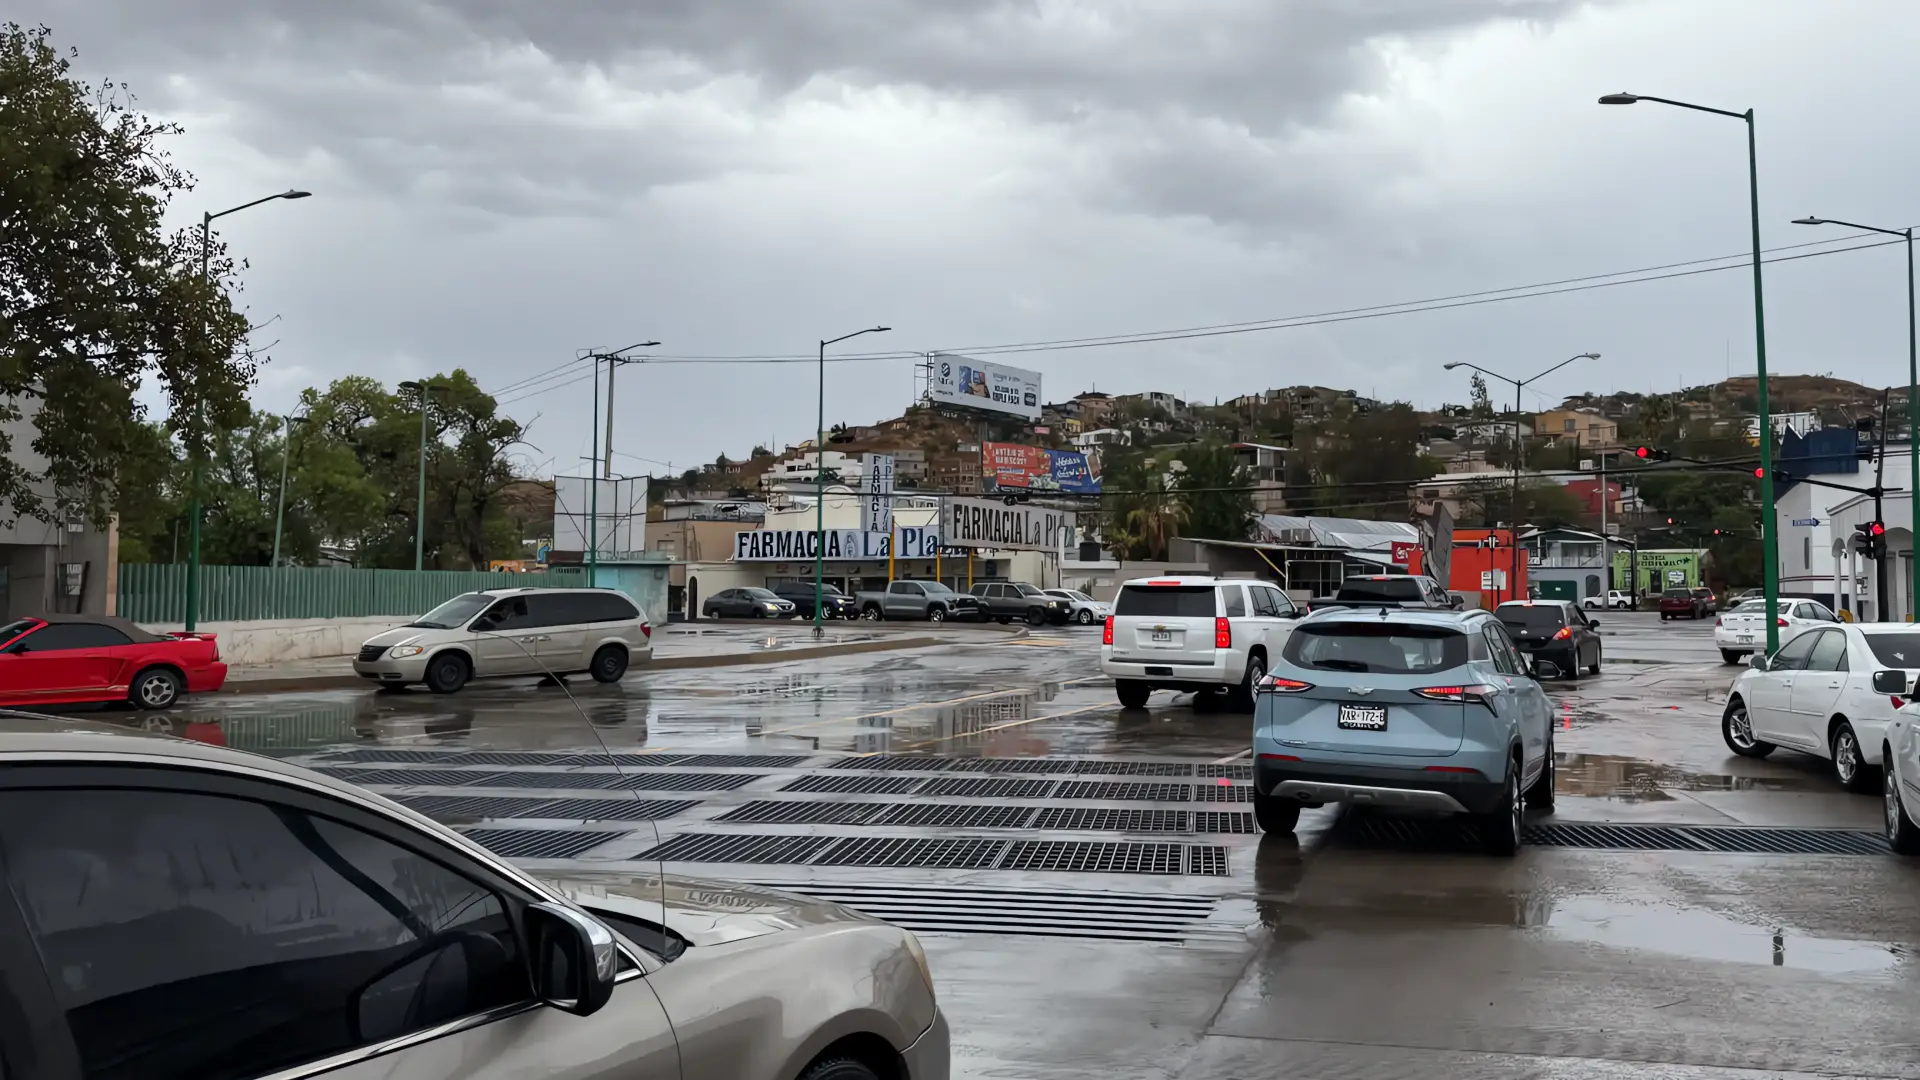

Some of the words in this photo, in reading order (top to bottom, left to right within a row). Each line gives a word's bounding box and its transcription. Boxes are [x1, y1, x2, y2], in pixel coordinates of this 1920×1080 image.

[871, 455, 881, 532] FARMACIA
[737, 531, 841, 558] FARMACIA
[863, 530, 891, 558] La
[953, 503, 1023, 545] FARMACIA
[1025, 510, 1041, 546] La
